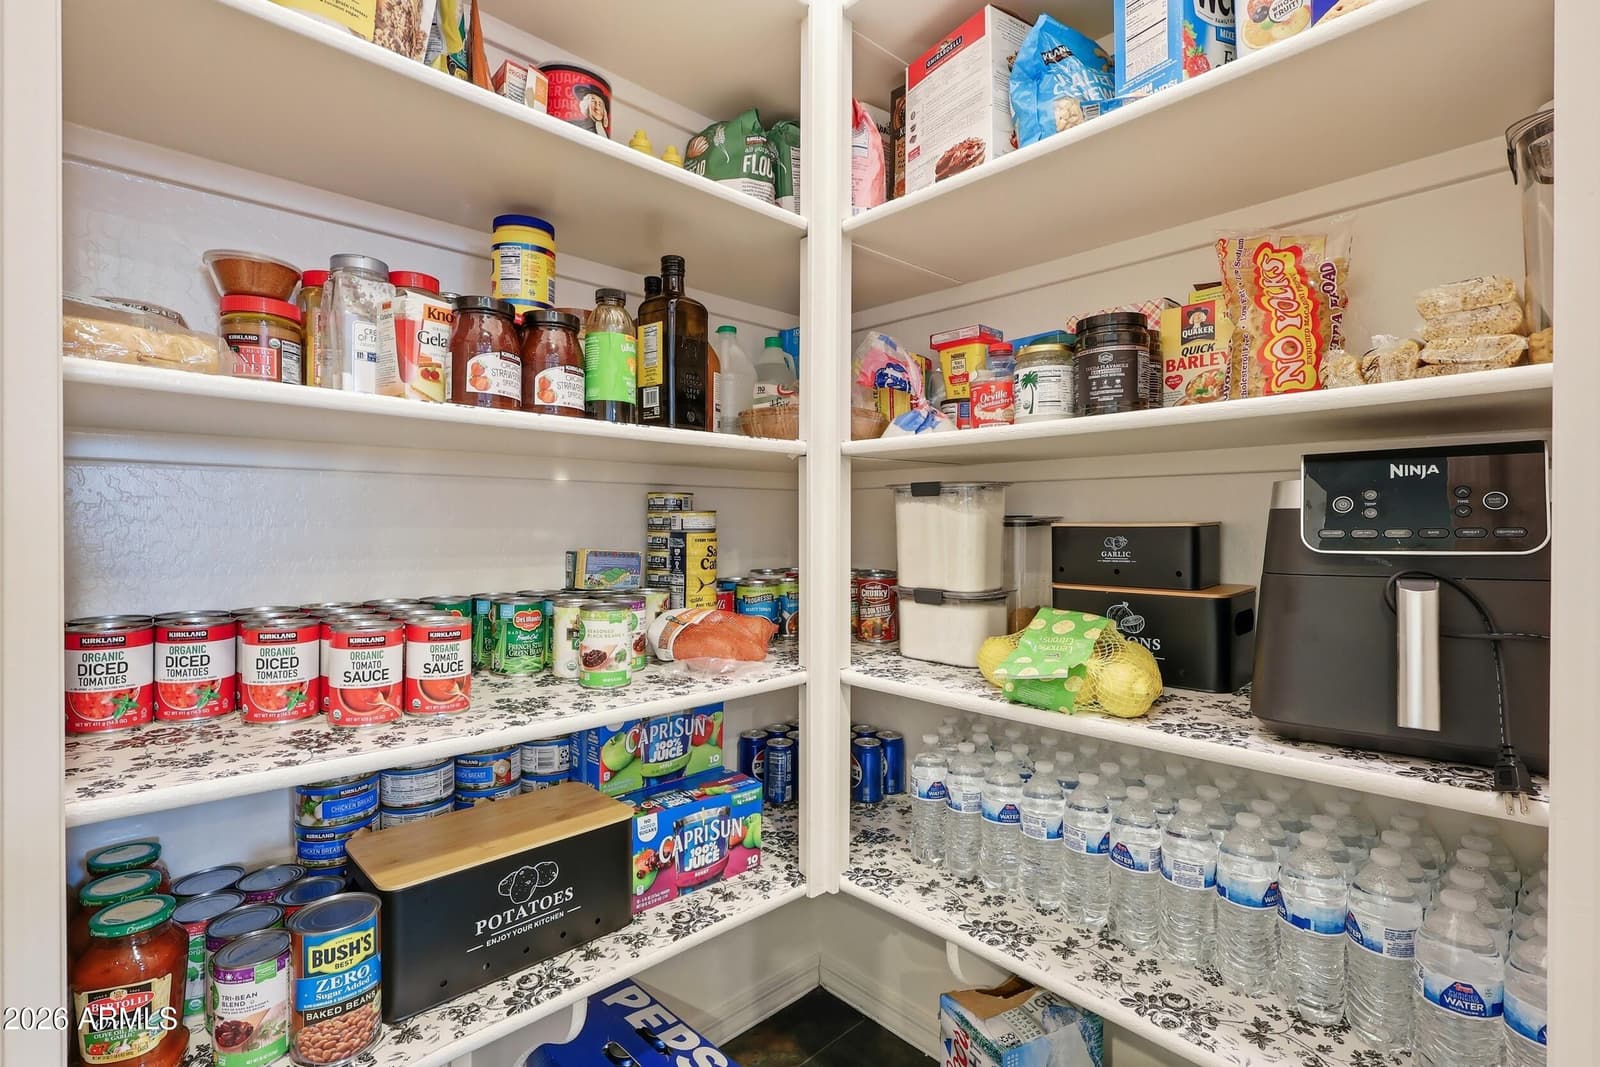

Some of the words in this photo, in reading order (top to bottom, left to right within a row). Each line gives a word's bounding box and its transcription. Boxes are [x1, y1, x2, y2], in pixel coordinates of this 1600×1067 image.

[1261, 253, 1303, 333] YOLKS
[1183, 325, 1214, 338] QUAKER
[1181, 343, 1216, 357] QUICK
[1165, 351, 1231, 373] BARLEY
[1269, 335, 1305, 388] NO
[1390, 463, 1439, 479] NINJA
[169, 631, 207, 639] KIRKLAND
[169, 645, 206, 654] ORGANIC
[260, 647, 296, 657] ORGANIC
[430, 643, 460, 653] ORGANIC
[82, 651, 124, 662] ORGANIC
[165, 654, 210, 668] DICED
[350, 650, 384, 660] ORGANIC
[432, 652, 458, 661] TOMATO
[77, 662, 129, 676] DICED
[256, 657, 299, 670] DICED
[352, 661, 381, 670] TOMATO
[424, 661, 464, 674] SAUCE
[167, 667, 209, 677] TOMATOES
[257, 669, 298, 679] TOMATOES
[343, 668, 389, 683] SAUCE
[79, 675, 127, 687] TOMATOES
[655, 738, 682, 751] 100%
[649, 744, 683, 763] JUICE
[709, 754, 719, 763] 10
[341, 785, 368, 794] KIRKLAND
[331, 803, 356, 813] CHICKEN
[658, 815, 743, 864] CAPRISUN
[690, 841, 718, 857] 100%
[684, 848, 720, 872] JUICE
[747, 855, 758, 864] 10
[474, 887, 575, 936] POTATOES
[486, 933, 511, 947] ENJOY
[512, 923, 533, 938] YOUR
[534, 911, 565, 928] KITCHEN
[312, 933, 372, 969] BUSH'S
[335, 959, 353, 969] BEST
[316, 964, 370, 993] ZERO
[316, 990, 343, 1001] Sugar
[345, 976, 371, 993] Added
[222, 992, 258, 1001] TRI-BEAN
[1443, 994, 1484, 1011] WATER
[306, 1007, 342, 1021] BAKED
[346, 990, 376, 1010] BEANS
[94, 1031, 113, 1039] OLIVE
[110, 1033, 133, 1041] GARLIC
